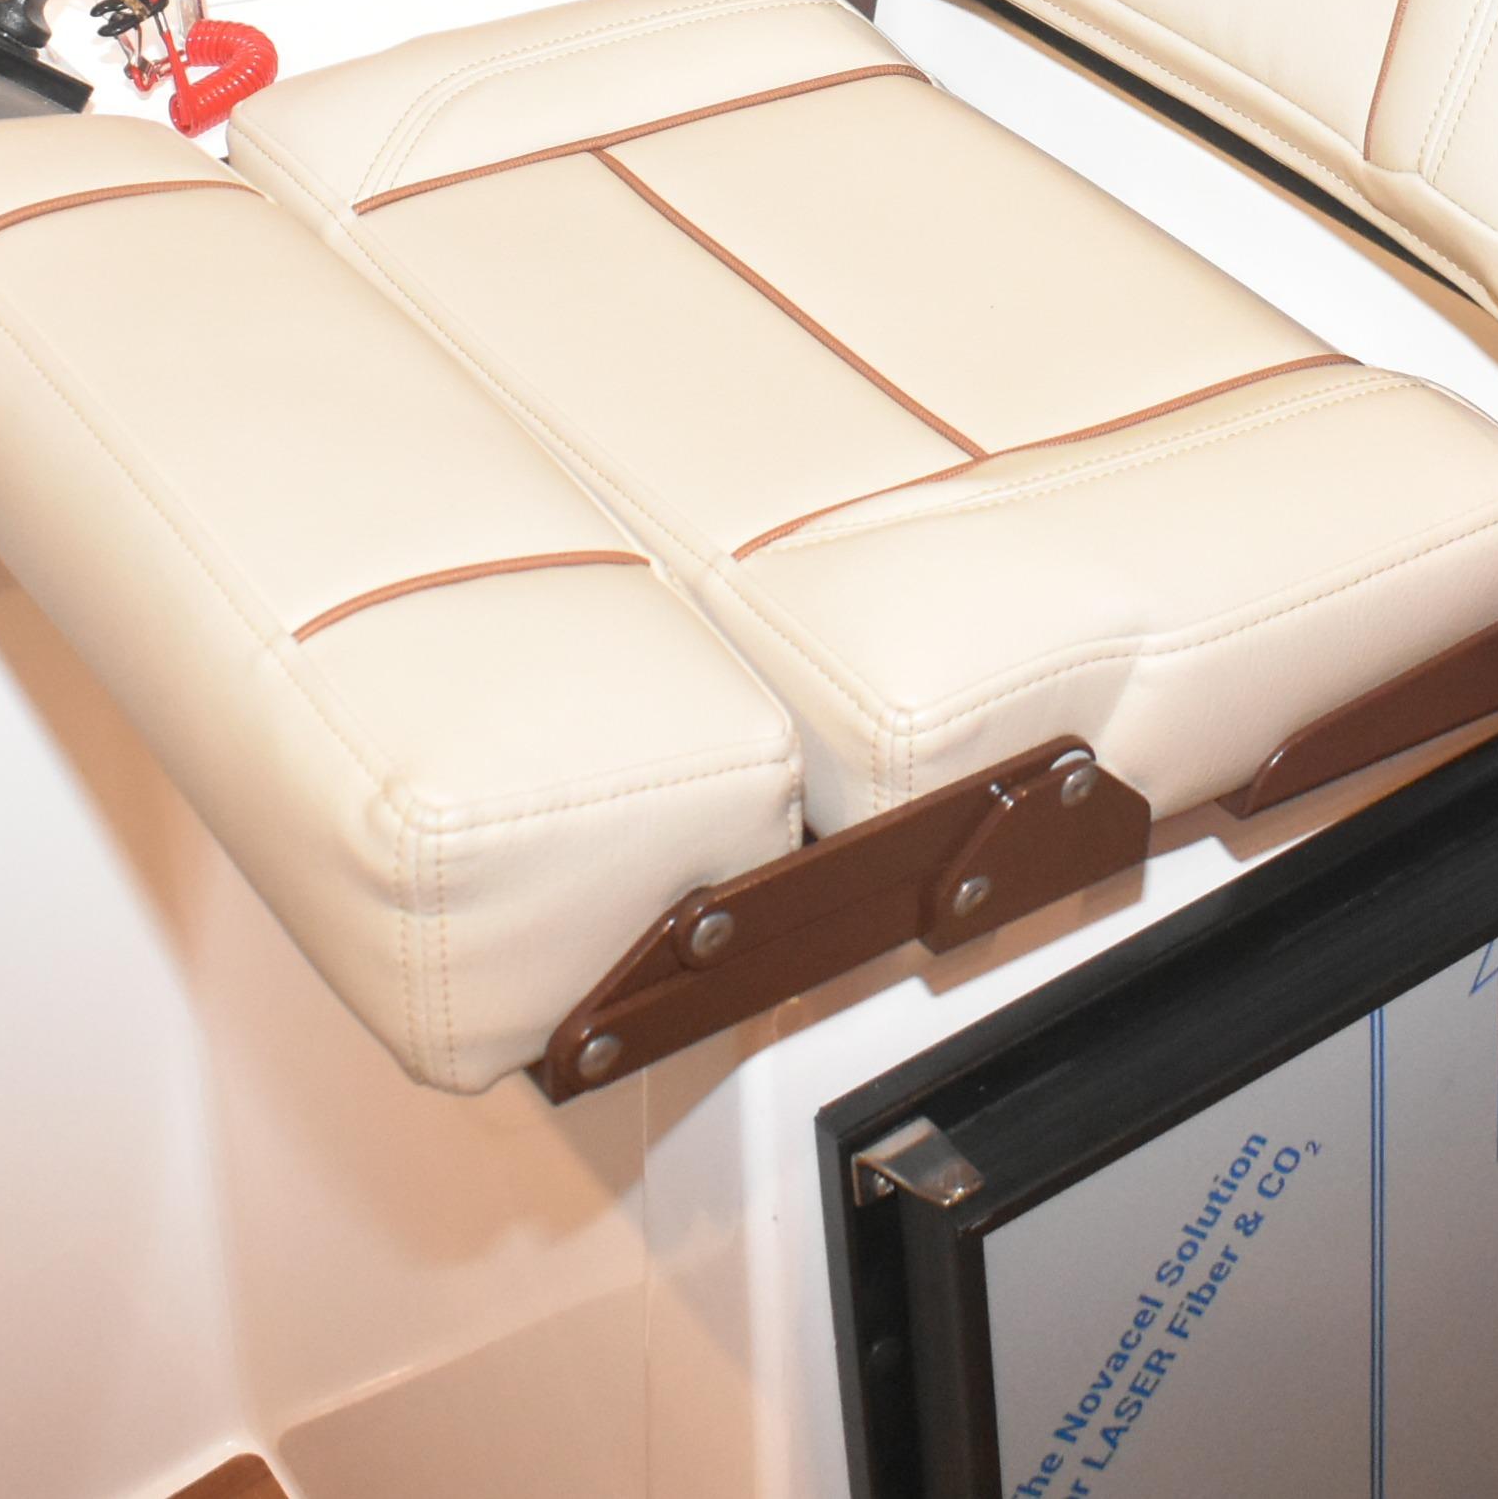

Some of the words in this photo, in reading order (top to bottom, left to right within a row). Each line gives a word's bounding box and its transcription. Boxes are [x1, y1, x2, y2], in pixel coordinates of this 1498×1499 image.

[1012, 1453, 1064, 1499] he
[1054, 1293, 1165, 1444] Novacel
[1156, 1133, 1268, 1288] Solution
[1082, 1348, 1177, 1471] LASER
[1165, 1244, 1239, 1339] Fiber
[1233, 1210, 1265, 1238] &
